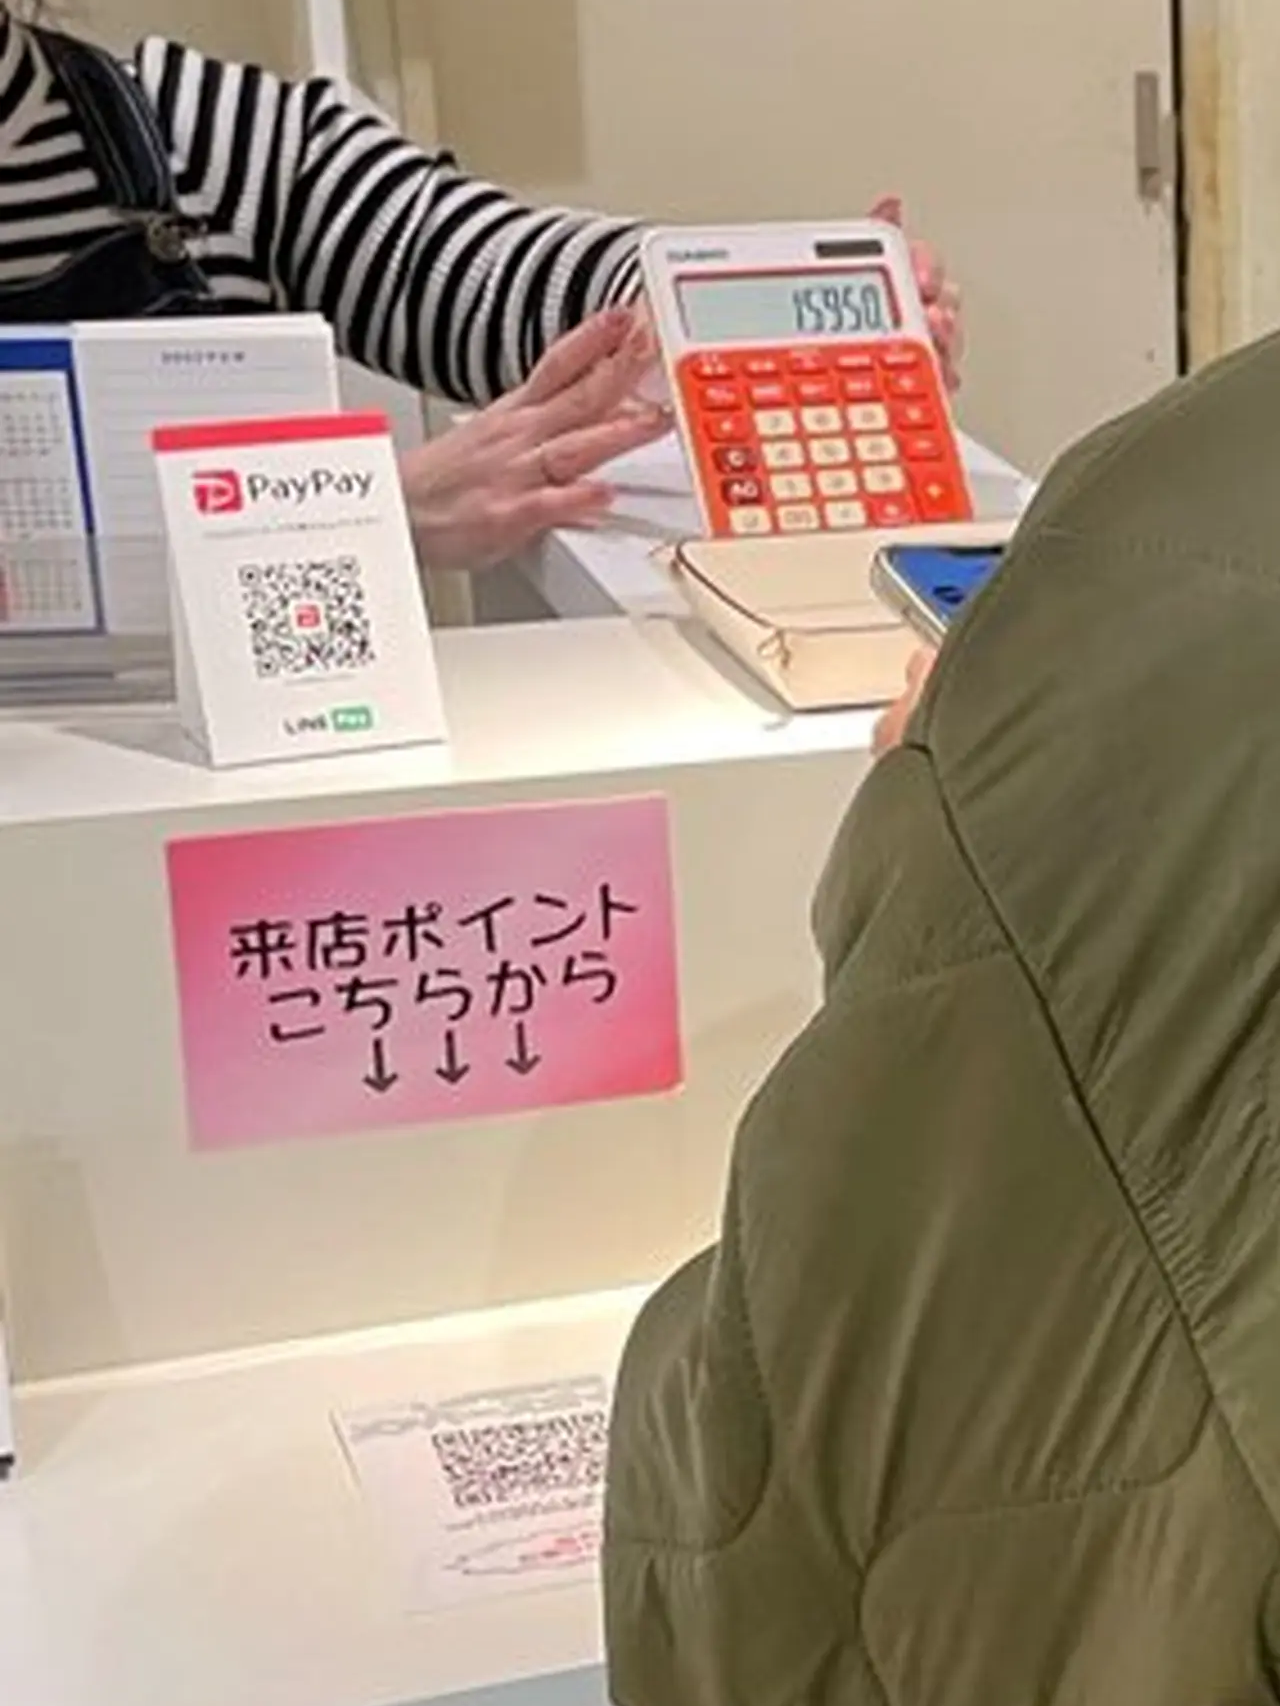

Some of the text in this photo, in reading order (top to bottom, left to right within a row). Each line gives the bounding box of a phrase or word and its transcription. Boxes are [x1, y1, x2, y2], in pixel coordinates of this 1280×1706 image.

[247, 469, 374, 504] PayPay
[229, 883, 638, 979] 来店ポイント
[269, 951, 617, 1042] こちらから
